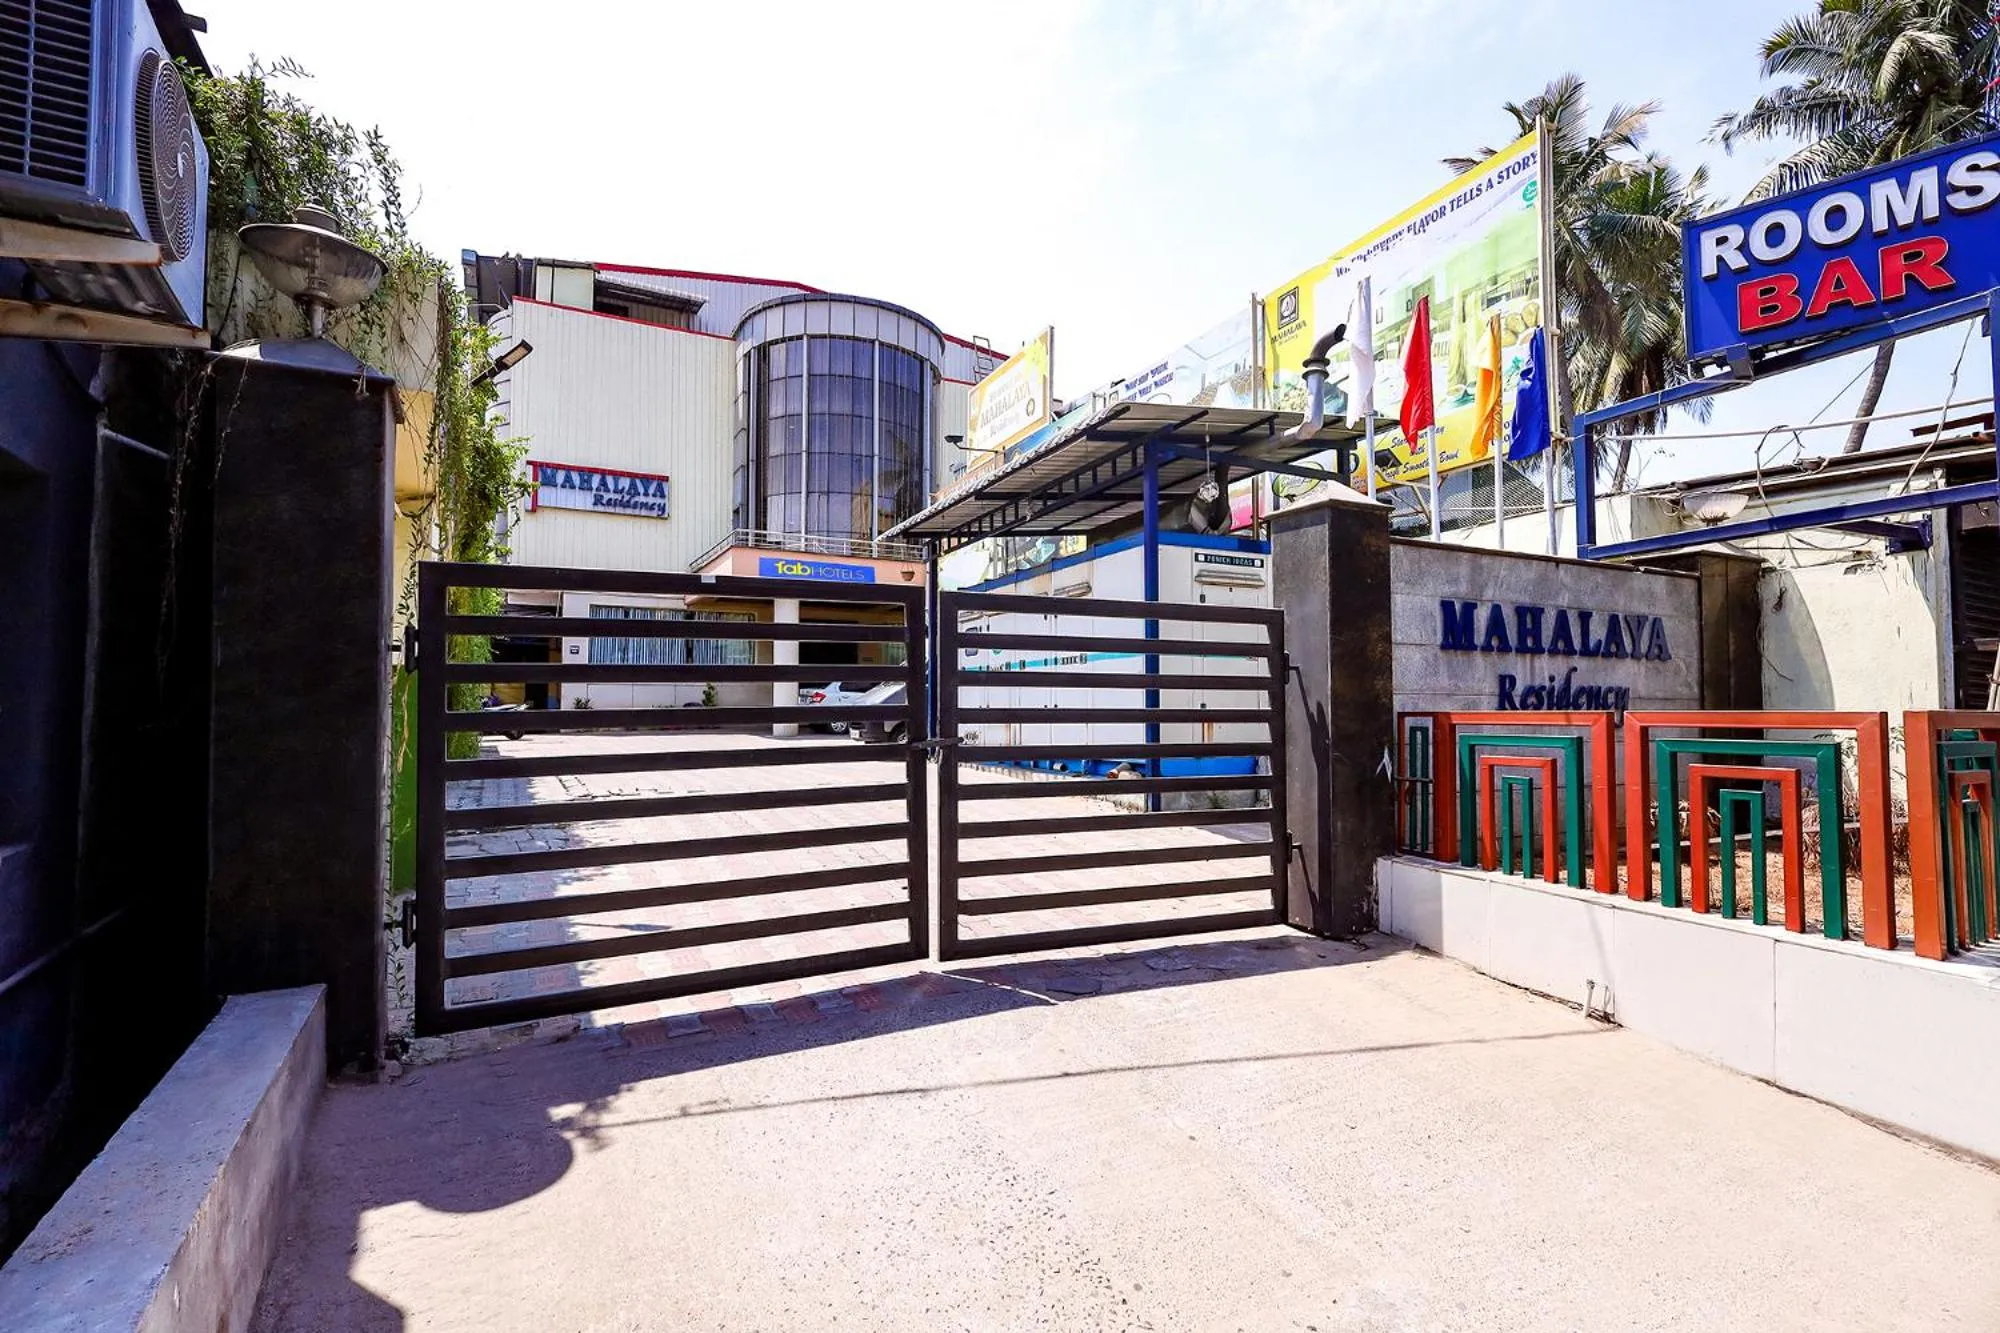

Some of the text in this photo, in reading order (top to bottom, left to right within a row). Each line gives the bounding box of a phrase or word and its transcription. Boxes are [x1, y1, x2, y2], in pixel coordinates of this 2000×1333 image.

[1449, 182, 1483, 213] TELLS
[1485, 177, 1495, 193] A
[1497, 150, 1538, 185] STORY
[1700, 151, 2000, 280] ROOMS
[1737, 235, 1957, 333] BAR
[540, 466, 667, 499] MAHALAYA
[592, 492, 667, 517] Residency
[1439, 600, 1673, 662] MAHALAYA
[1496, 666, 1631, 728] Residency
